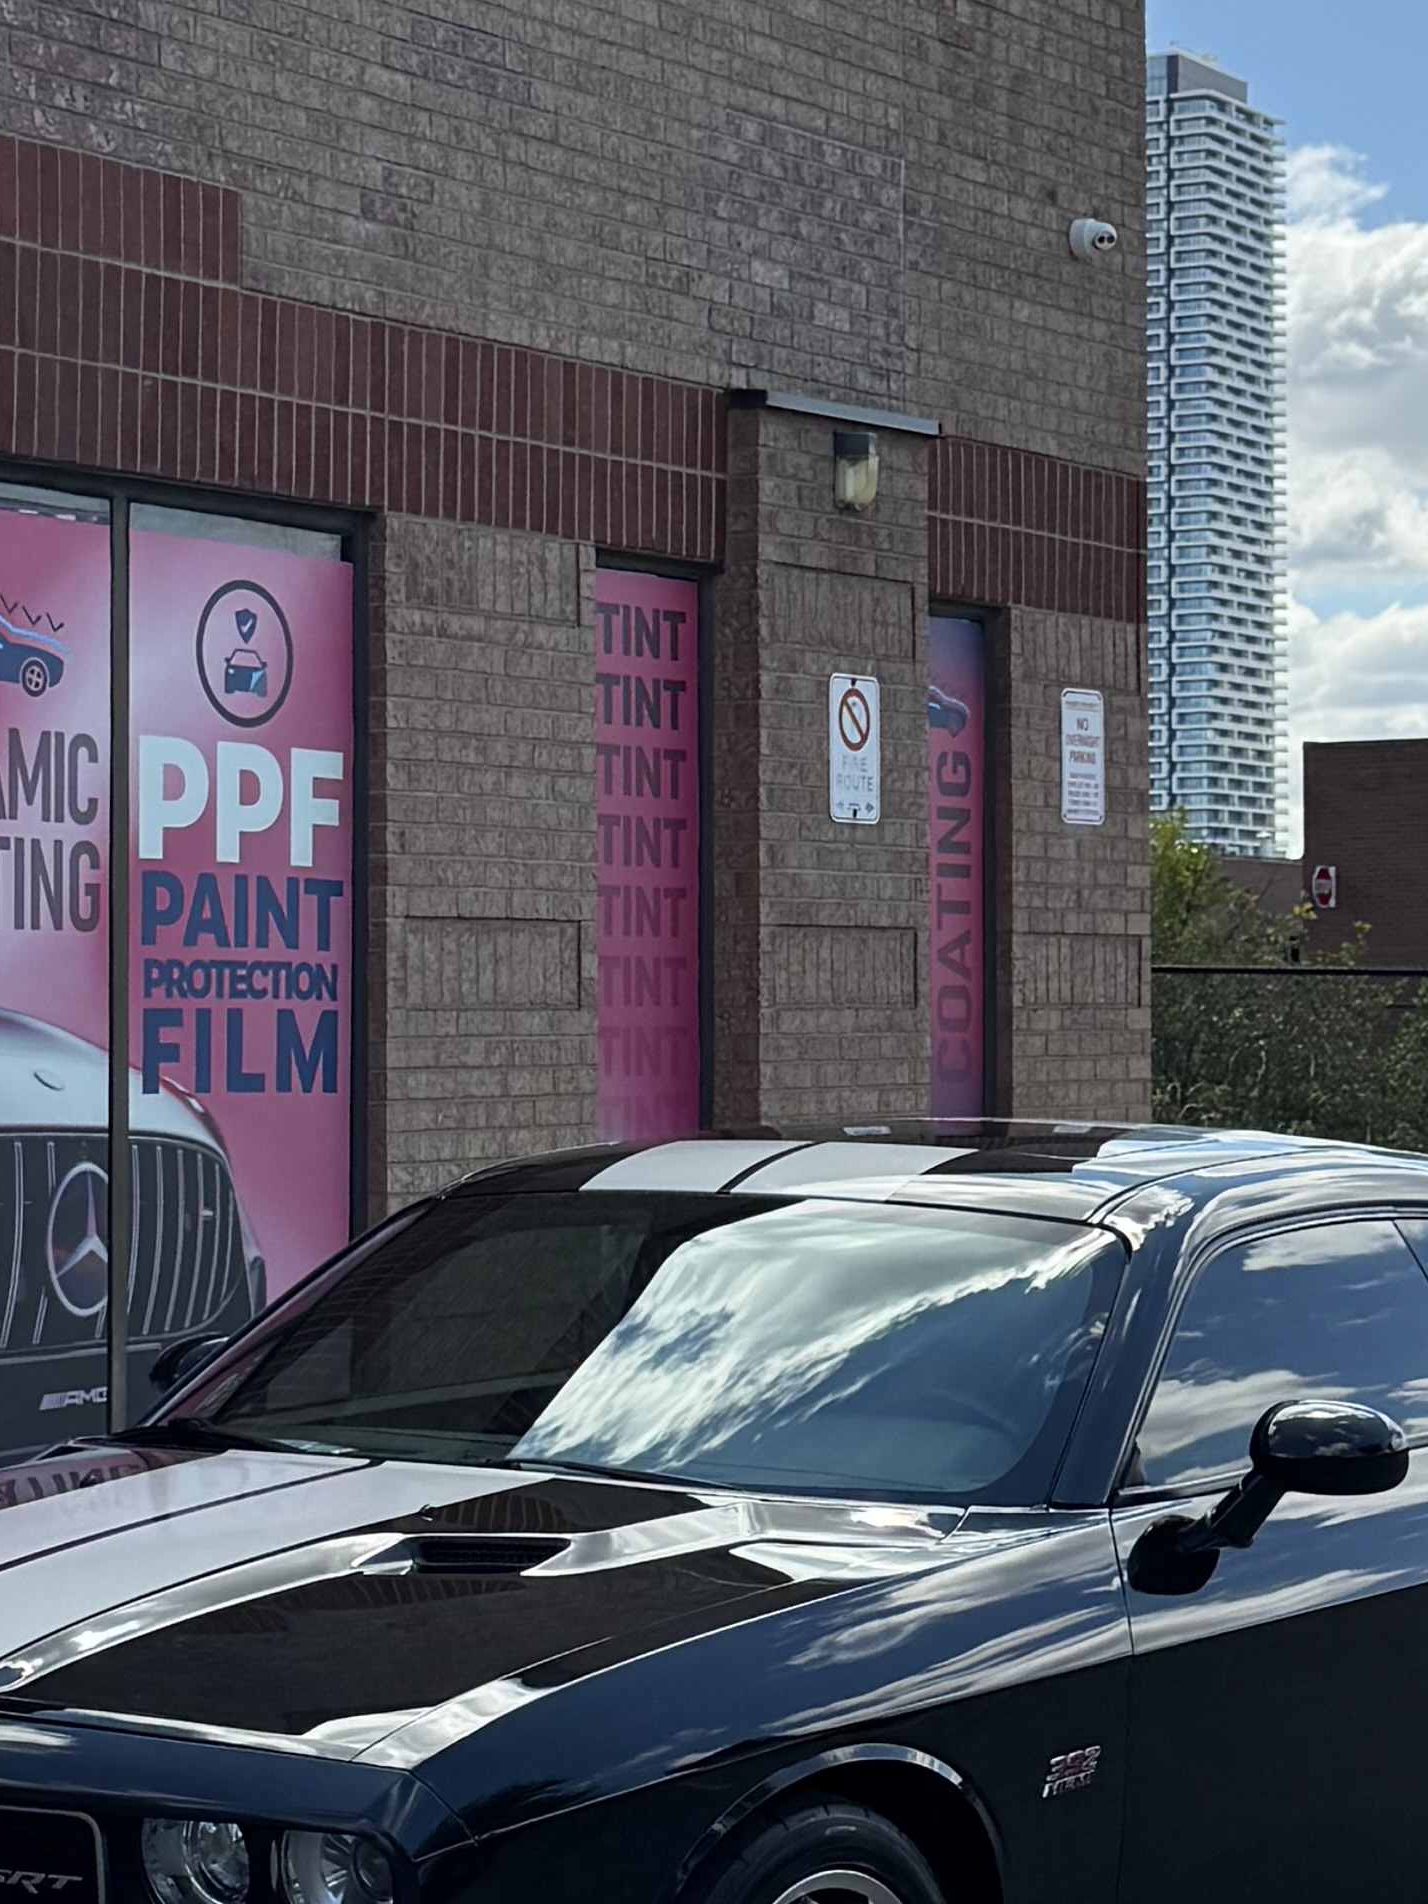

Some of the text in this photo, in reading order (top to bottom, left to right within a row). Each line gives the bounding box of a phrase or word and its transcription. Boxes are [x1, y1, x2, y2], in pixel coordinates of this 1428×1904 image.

[596, 601, 687, 661] TINT
[595, 672, 687, 731] TINT
[596, 743, 687, 799] TINT
[836, 773, 874, 792] ROUTE
[138, 734, 344, 868] PPF
[597, 814, 688, 869] TINT
[140, 870, 344, 952] PAINT
[598, 885, 688, 938] TINT
[936, 751, 972, 1084] COATING
[143, 957, 339, 1002] PROTECTION
[598, 955, 688, 1008] TINT
[141, 1007, 339, 1095] FILM
